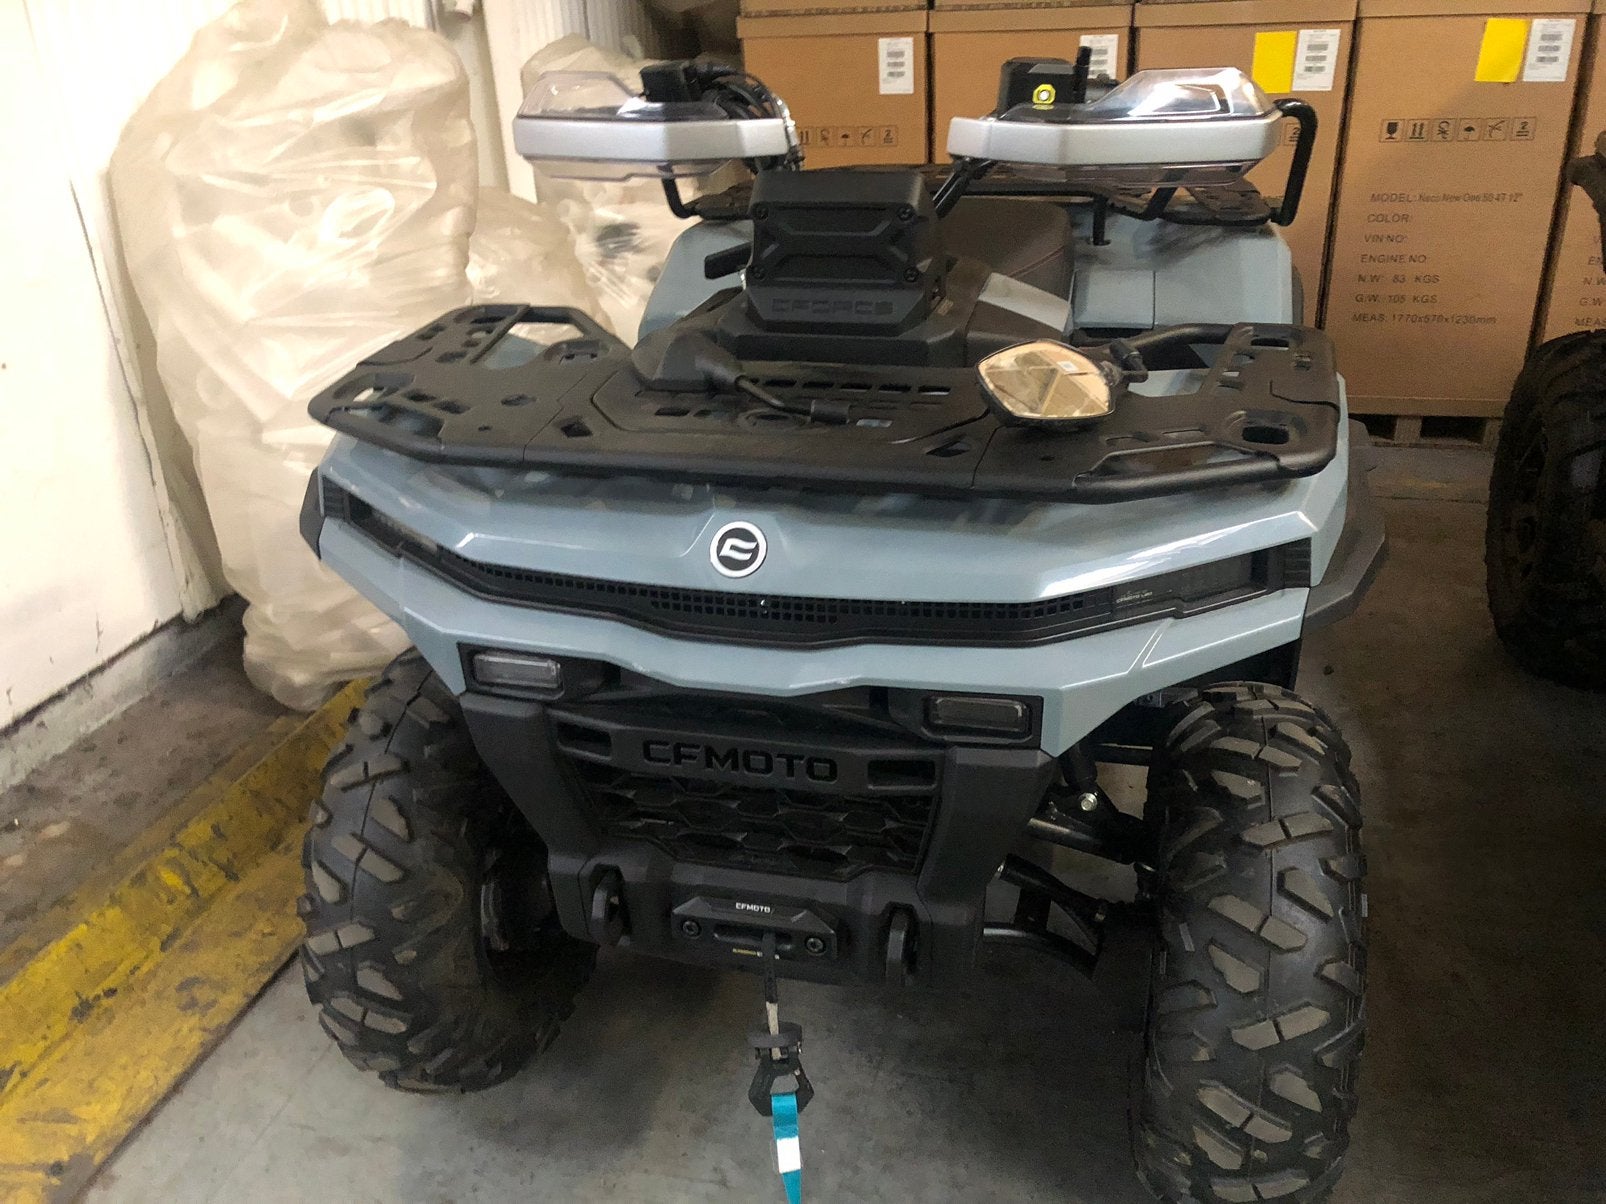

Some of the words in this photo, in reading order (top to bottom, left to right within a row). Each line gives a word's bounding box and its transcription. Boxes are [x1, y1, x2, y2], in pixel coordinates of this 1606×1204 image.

[1414, 274, 1440, 284] KGS
[1412, 294, 1438, 304] KGS
[642, 739, 839, 784] CFMOTO
[735, 902, 771, 914] CFMOTO
